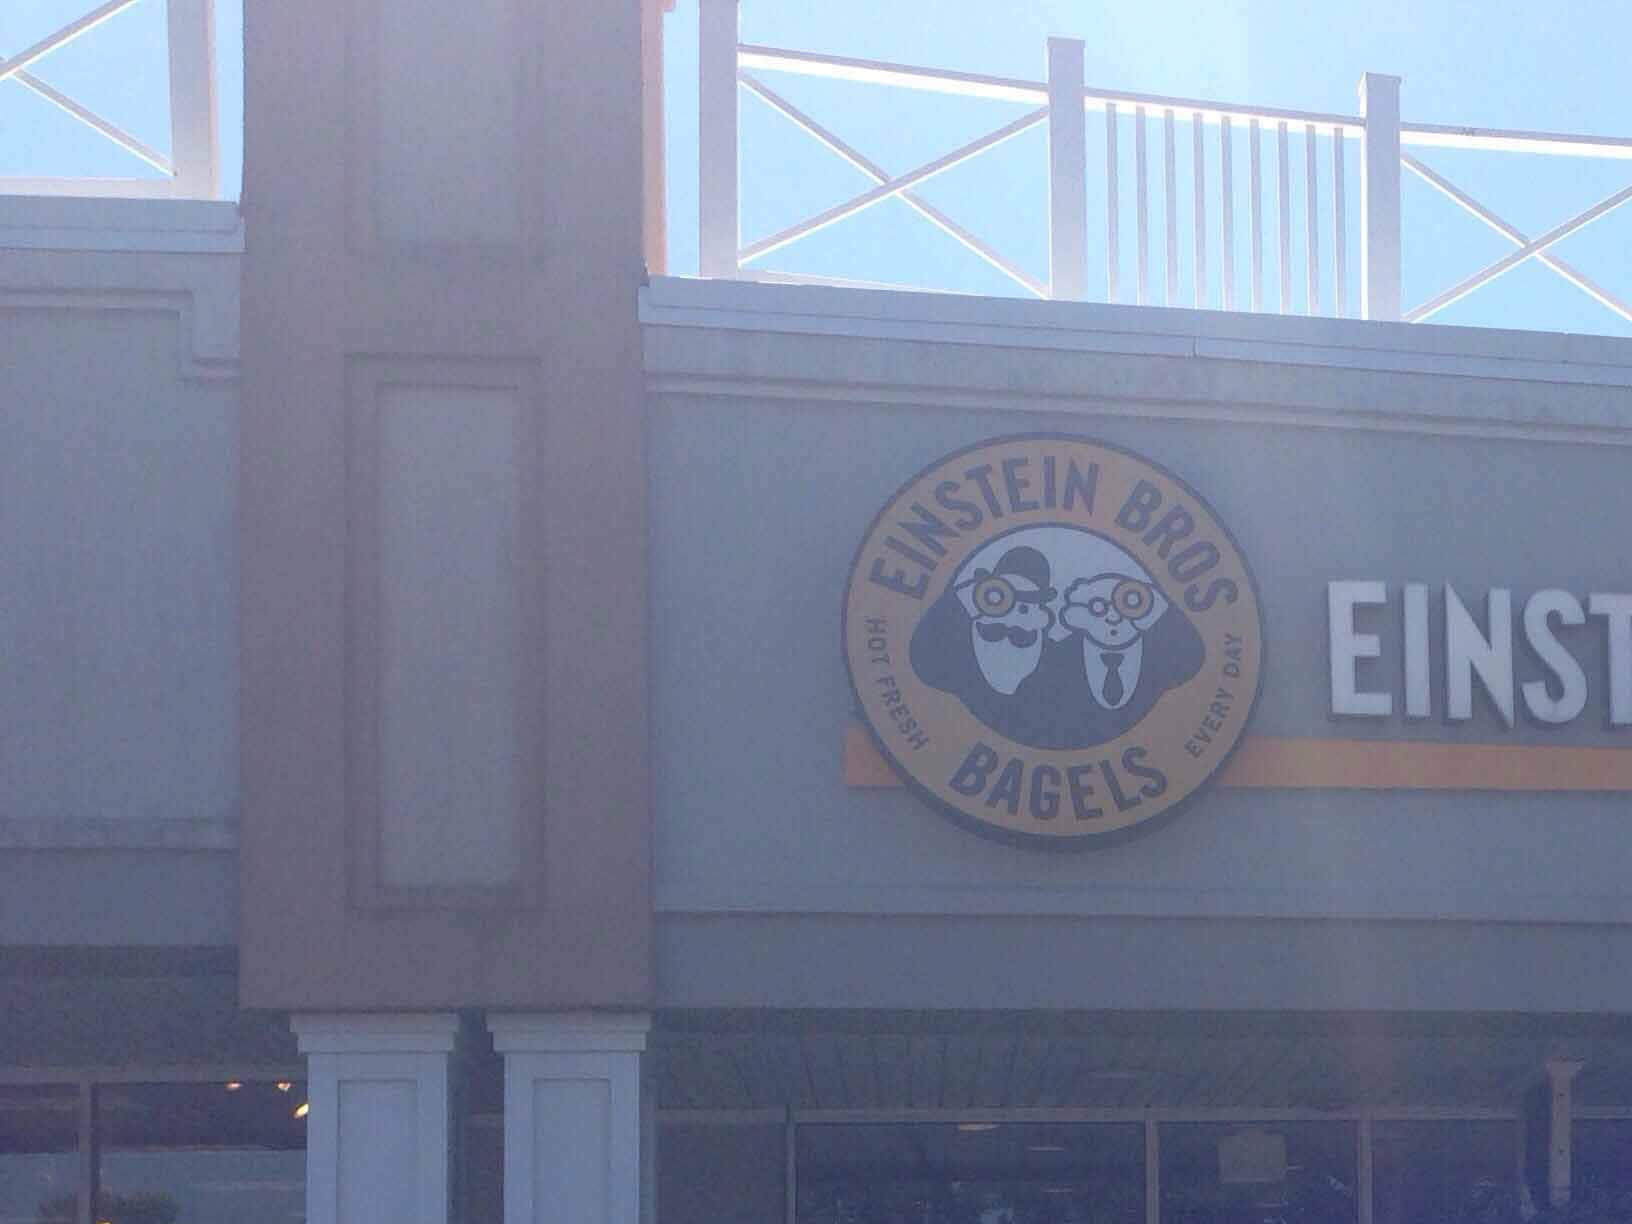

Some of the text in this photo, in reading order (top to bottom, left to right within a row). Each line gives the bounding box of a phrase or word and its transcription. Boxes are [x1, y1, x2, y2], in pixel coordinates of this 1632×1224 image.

[869, 455, 1238, 613] EINSTEIN BROS
[865, 615, 929, 751] HOT FRESH
[1184, 632, 1243, 759] EVERY DAY
[948, 740, 1168, 822] BAGELS
